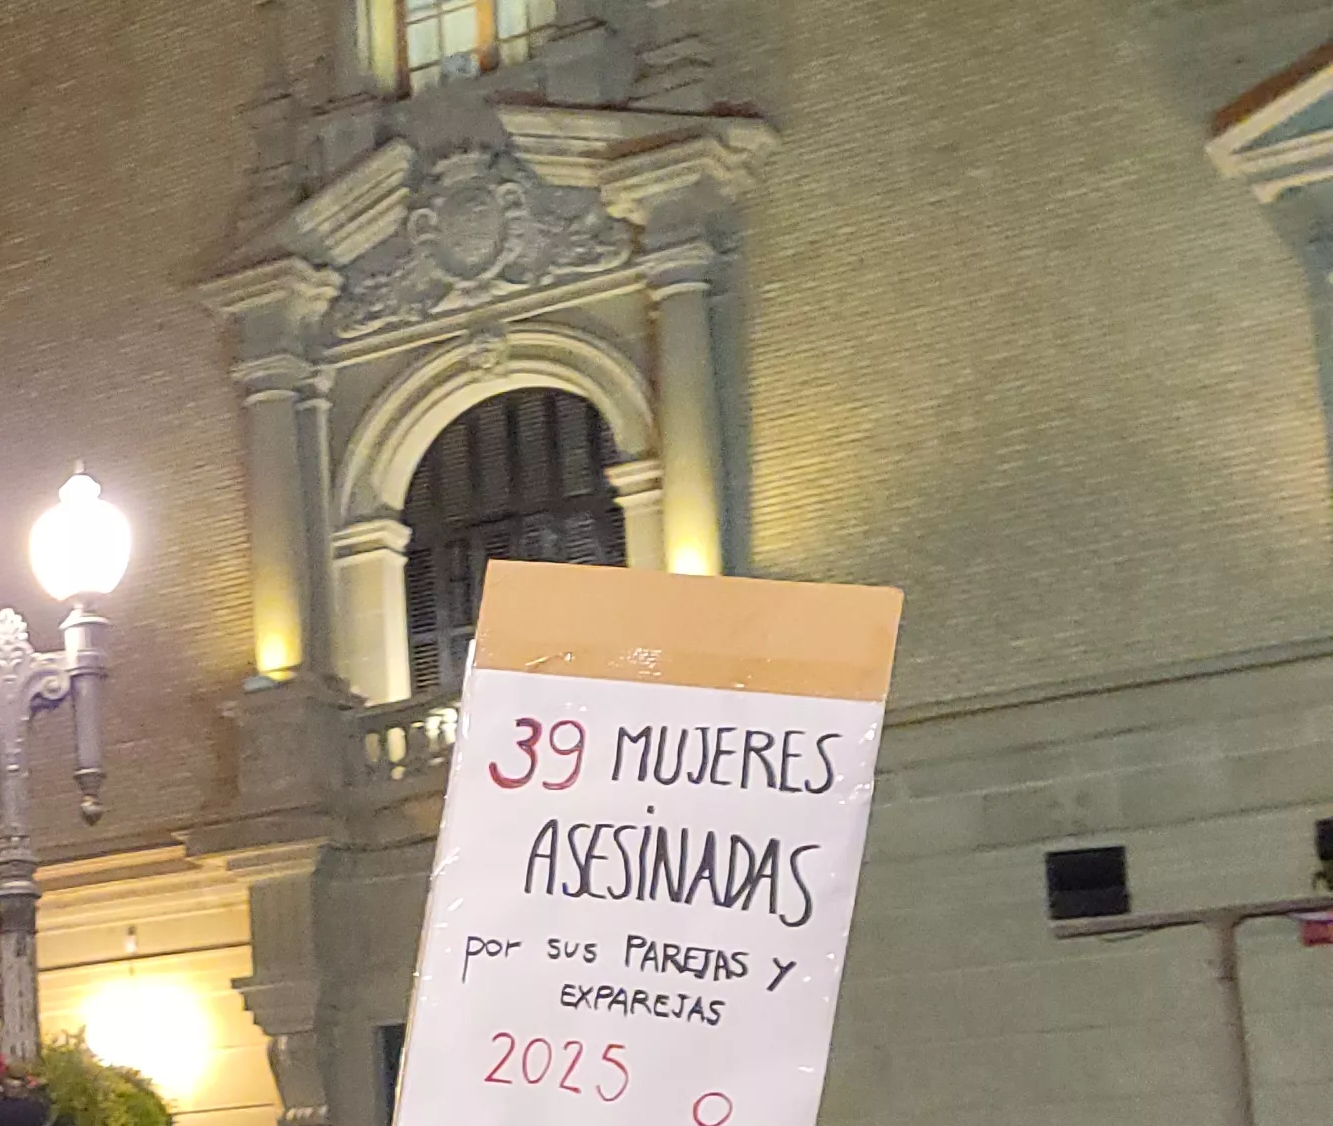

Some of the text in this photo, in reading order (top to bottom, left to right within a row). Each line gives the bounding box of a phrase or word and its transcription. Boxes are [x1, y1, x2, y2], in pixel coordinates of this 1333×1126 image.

[489, 718, 841, 794] 39 MUJERES
[462, 936, 521, 982] por
[625, 935, 749, 981] PAREJAS
[561, 984, 725, 1026] EXPAREJAS
[485, 1032, 628, 1101] 2025
